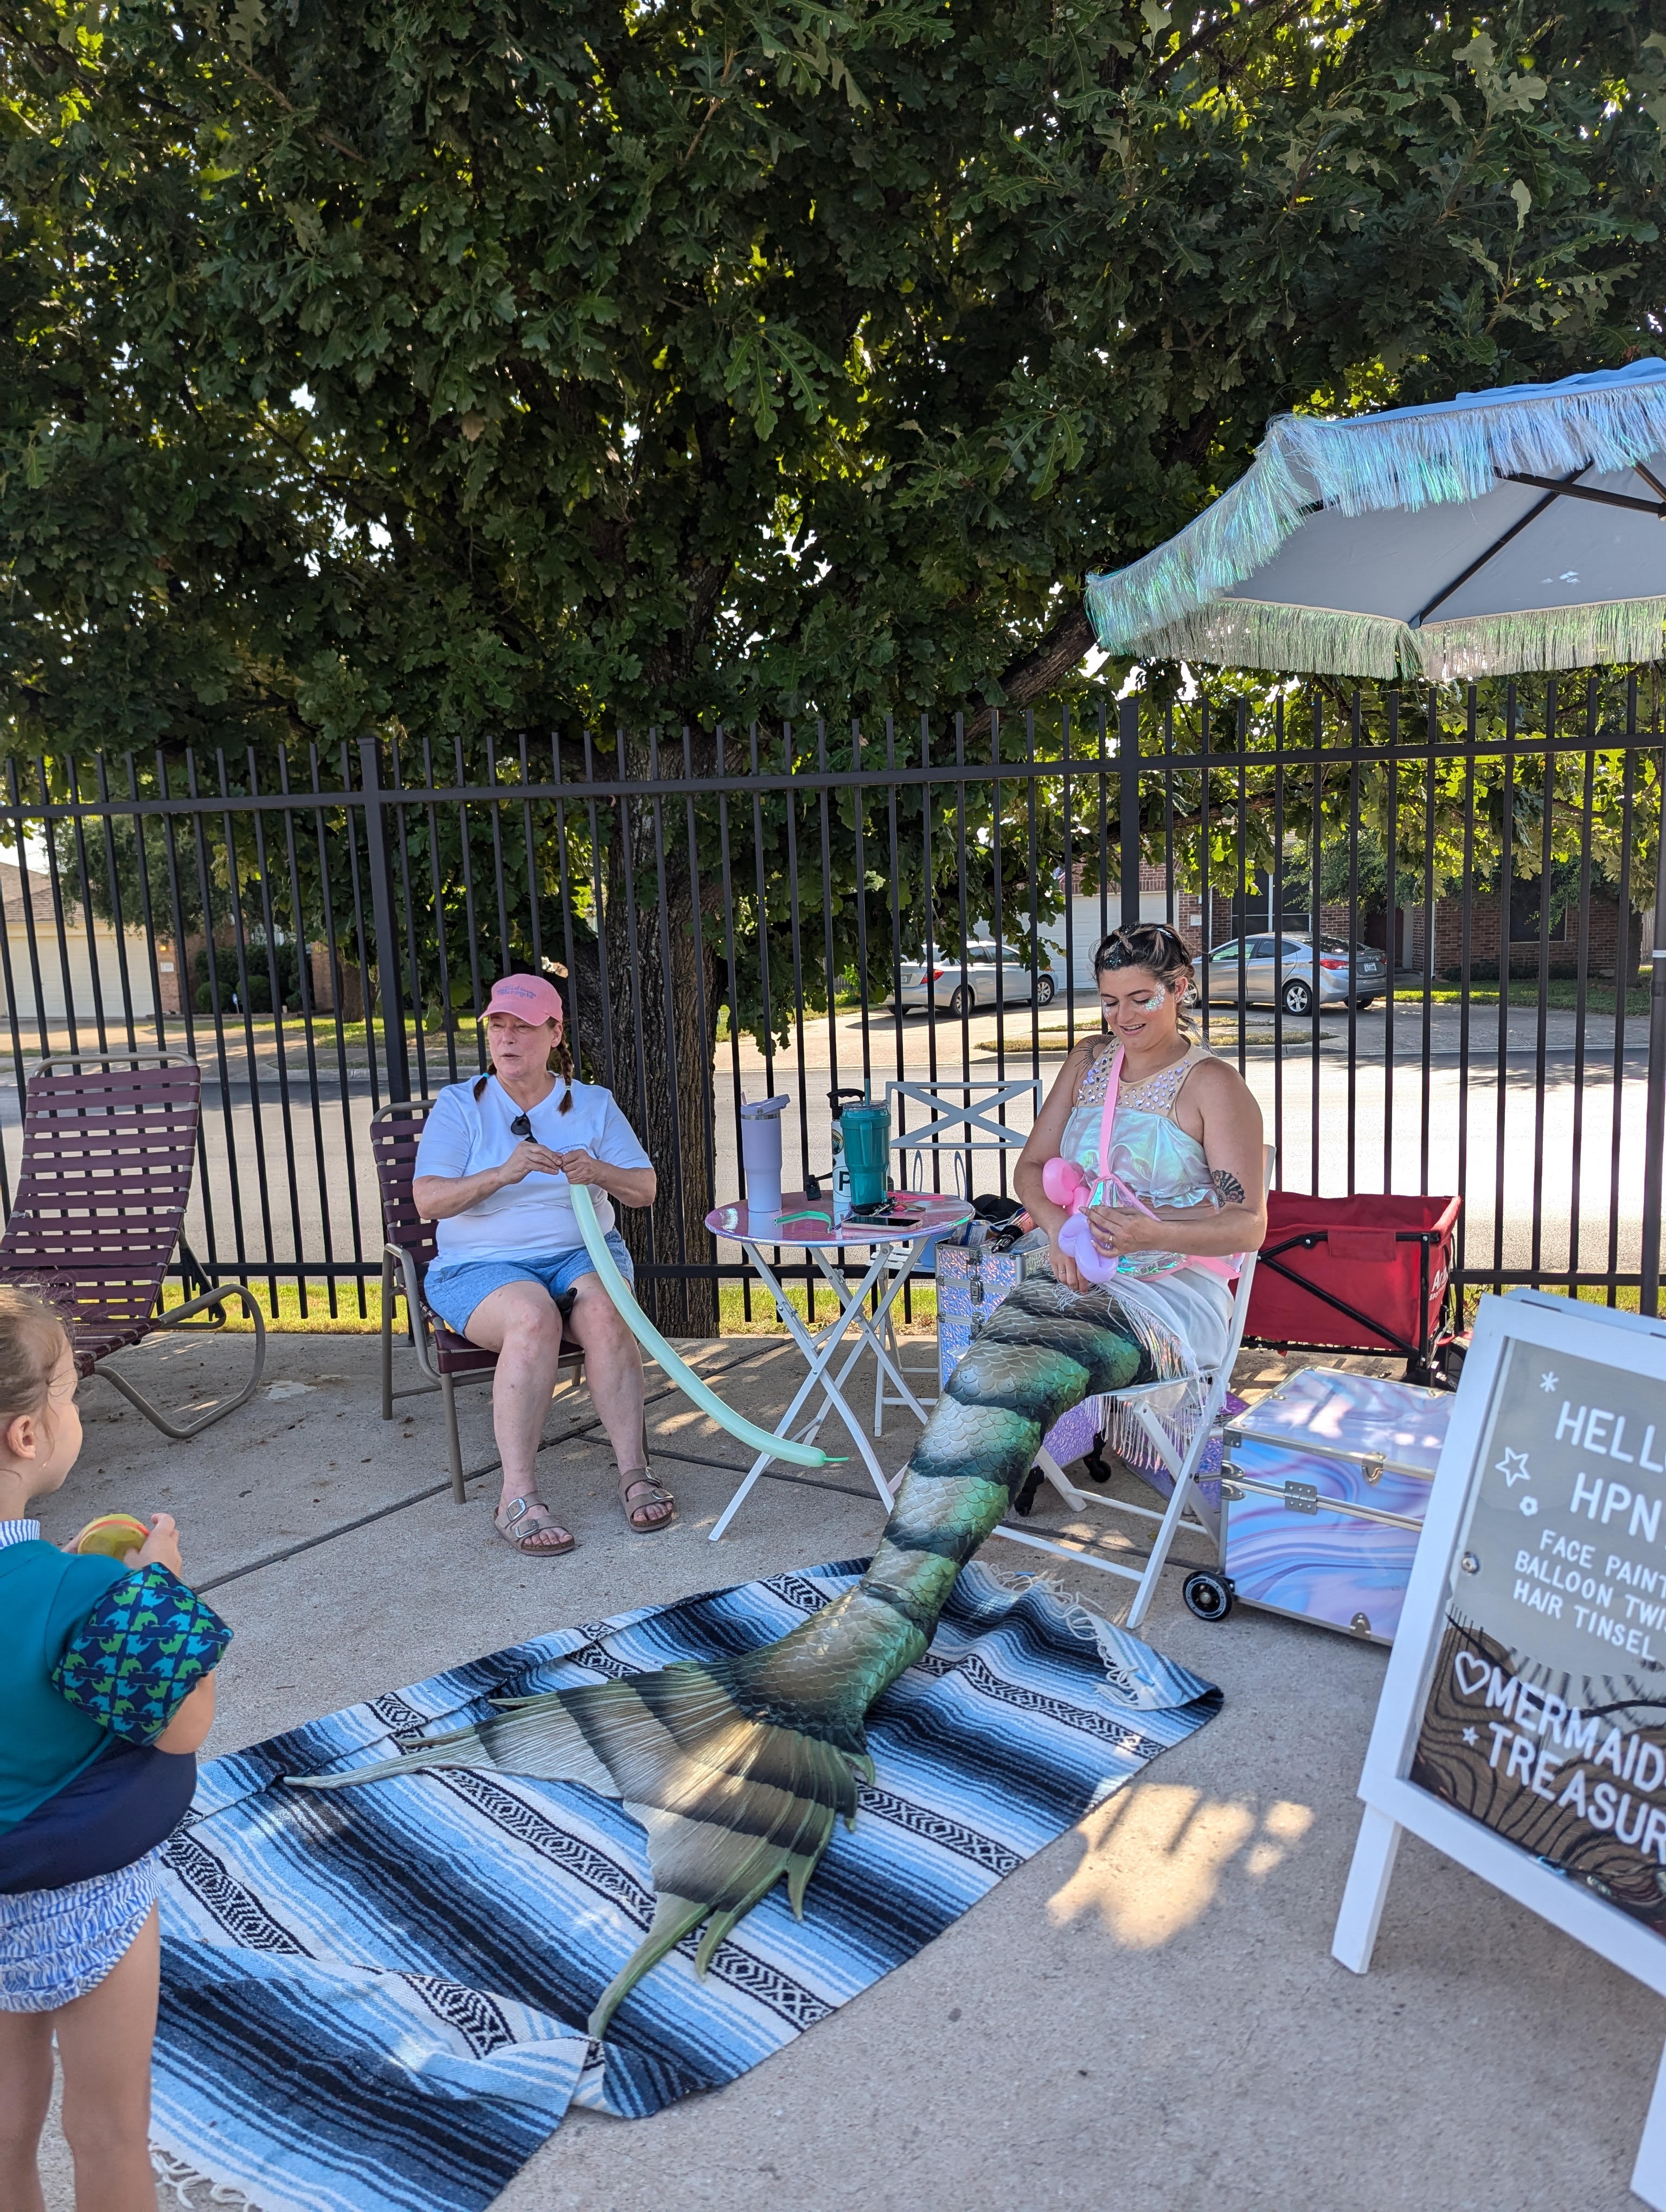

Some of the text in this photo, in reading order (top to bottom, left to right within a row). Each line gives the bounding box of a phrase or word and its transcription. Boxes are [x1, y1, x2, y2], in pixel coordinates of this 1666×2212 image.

[1555, 1400, 1666, 1474] HELL
[1540, 1529, 1596, 1570] FACE
[1513, 1579, 1657, 1661] HAIR TINSEL
[1515, 1549, 1666, 1634] BALLOON TWI
[1489, 1721, 1666, 1865] TREASUR
